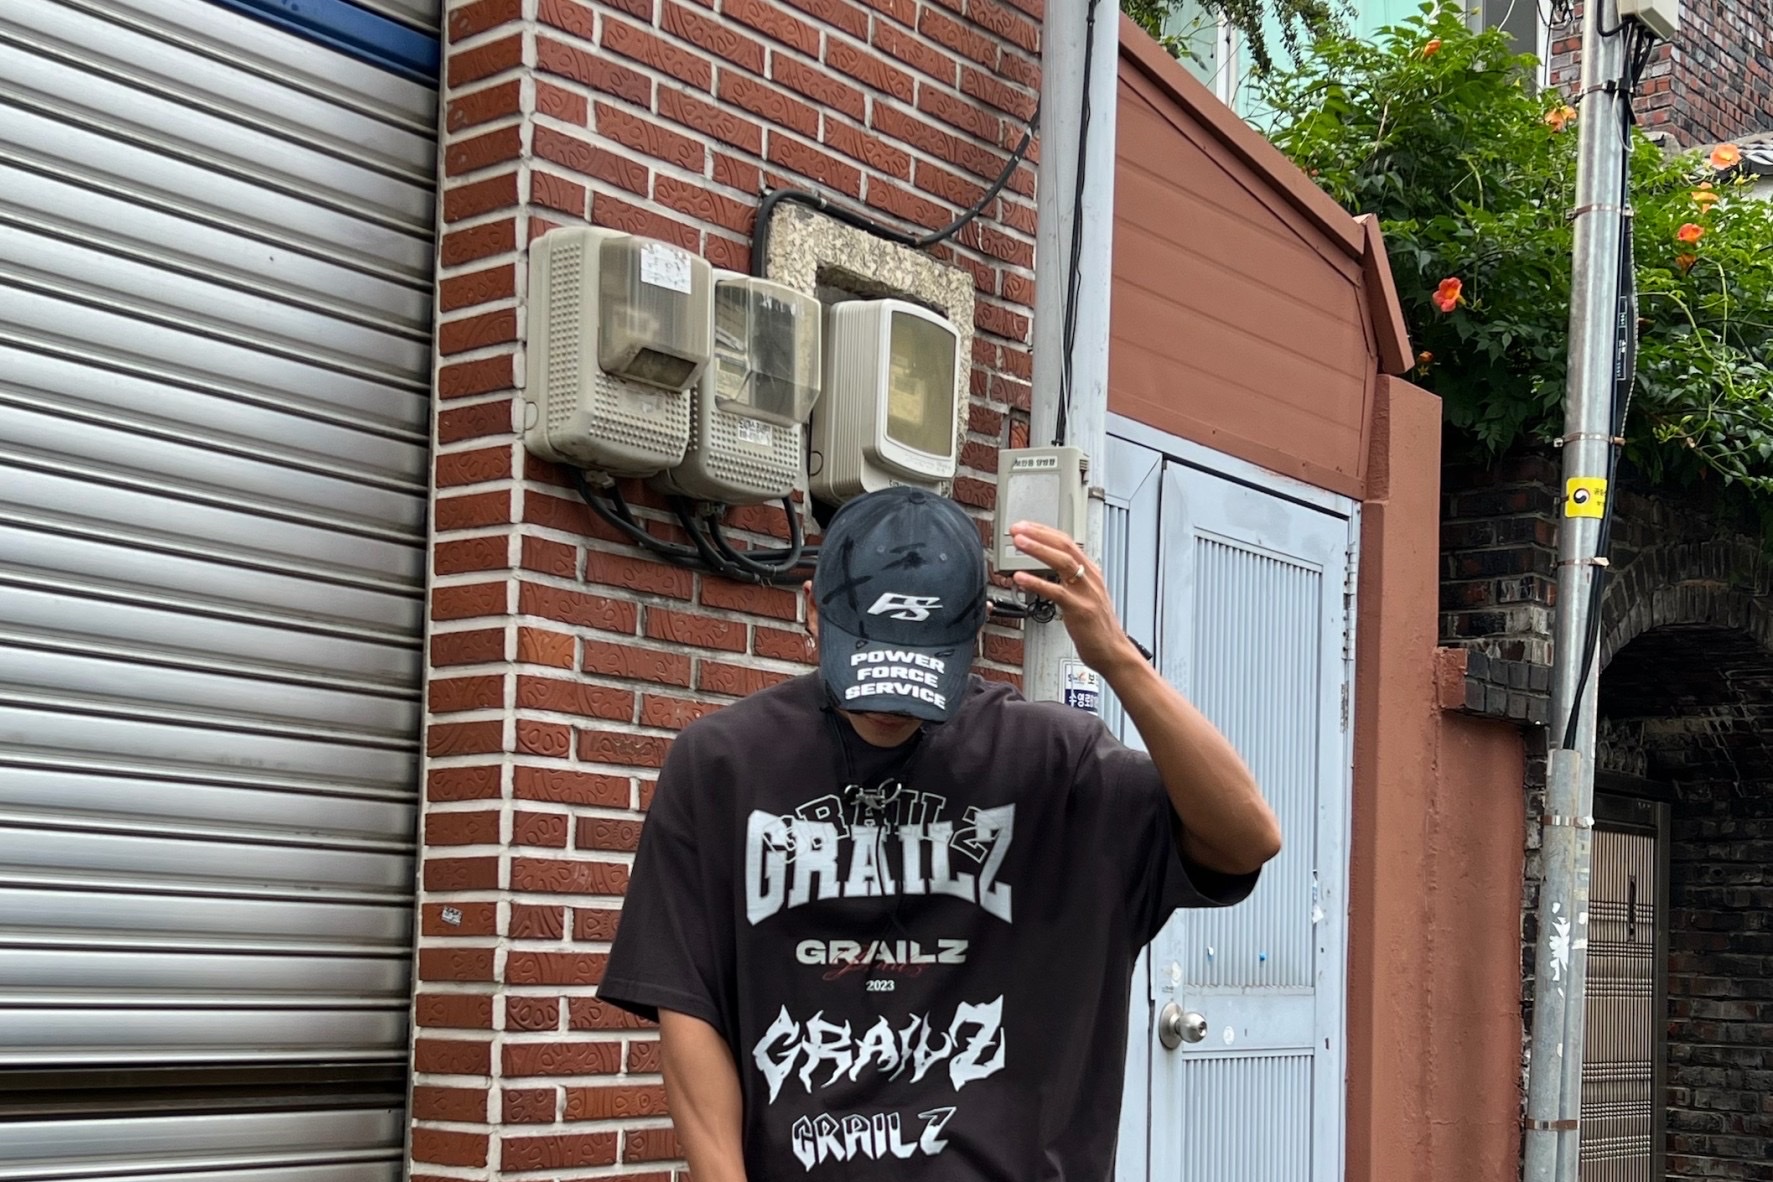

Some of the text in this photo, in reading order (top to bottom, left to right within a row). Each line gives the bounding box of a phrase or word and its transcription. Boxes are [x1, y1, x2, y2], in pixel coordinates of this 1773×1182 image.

[850, 649, 945, 674] POWER
[857, 666, 939, 689] FORCE
[844, 681, 947, 711] SERVICE
[745, 802, 1016, 926] GRAILZ
[795, 939, 969, 965] GRAILZ
[865, 979, 896, 992] 2023
[752, 994, 1006, 1105] GRAILZ
[792, 1106, 957, 1172] GRAILZ
